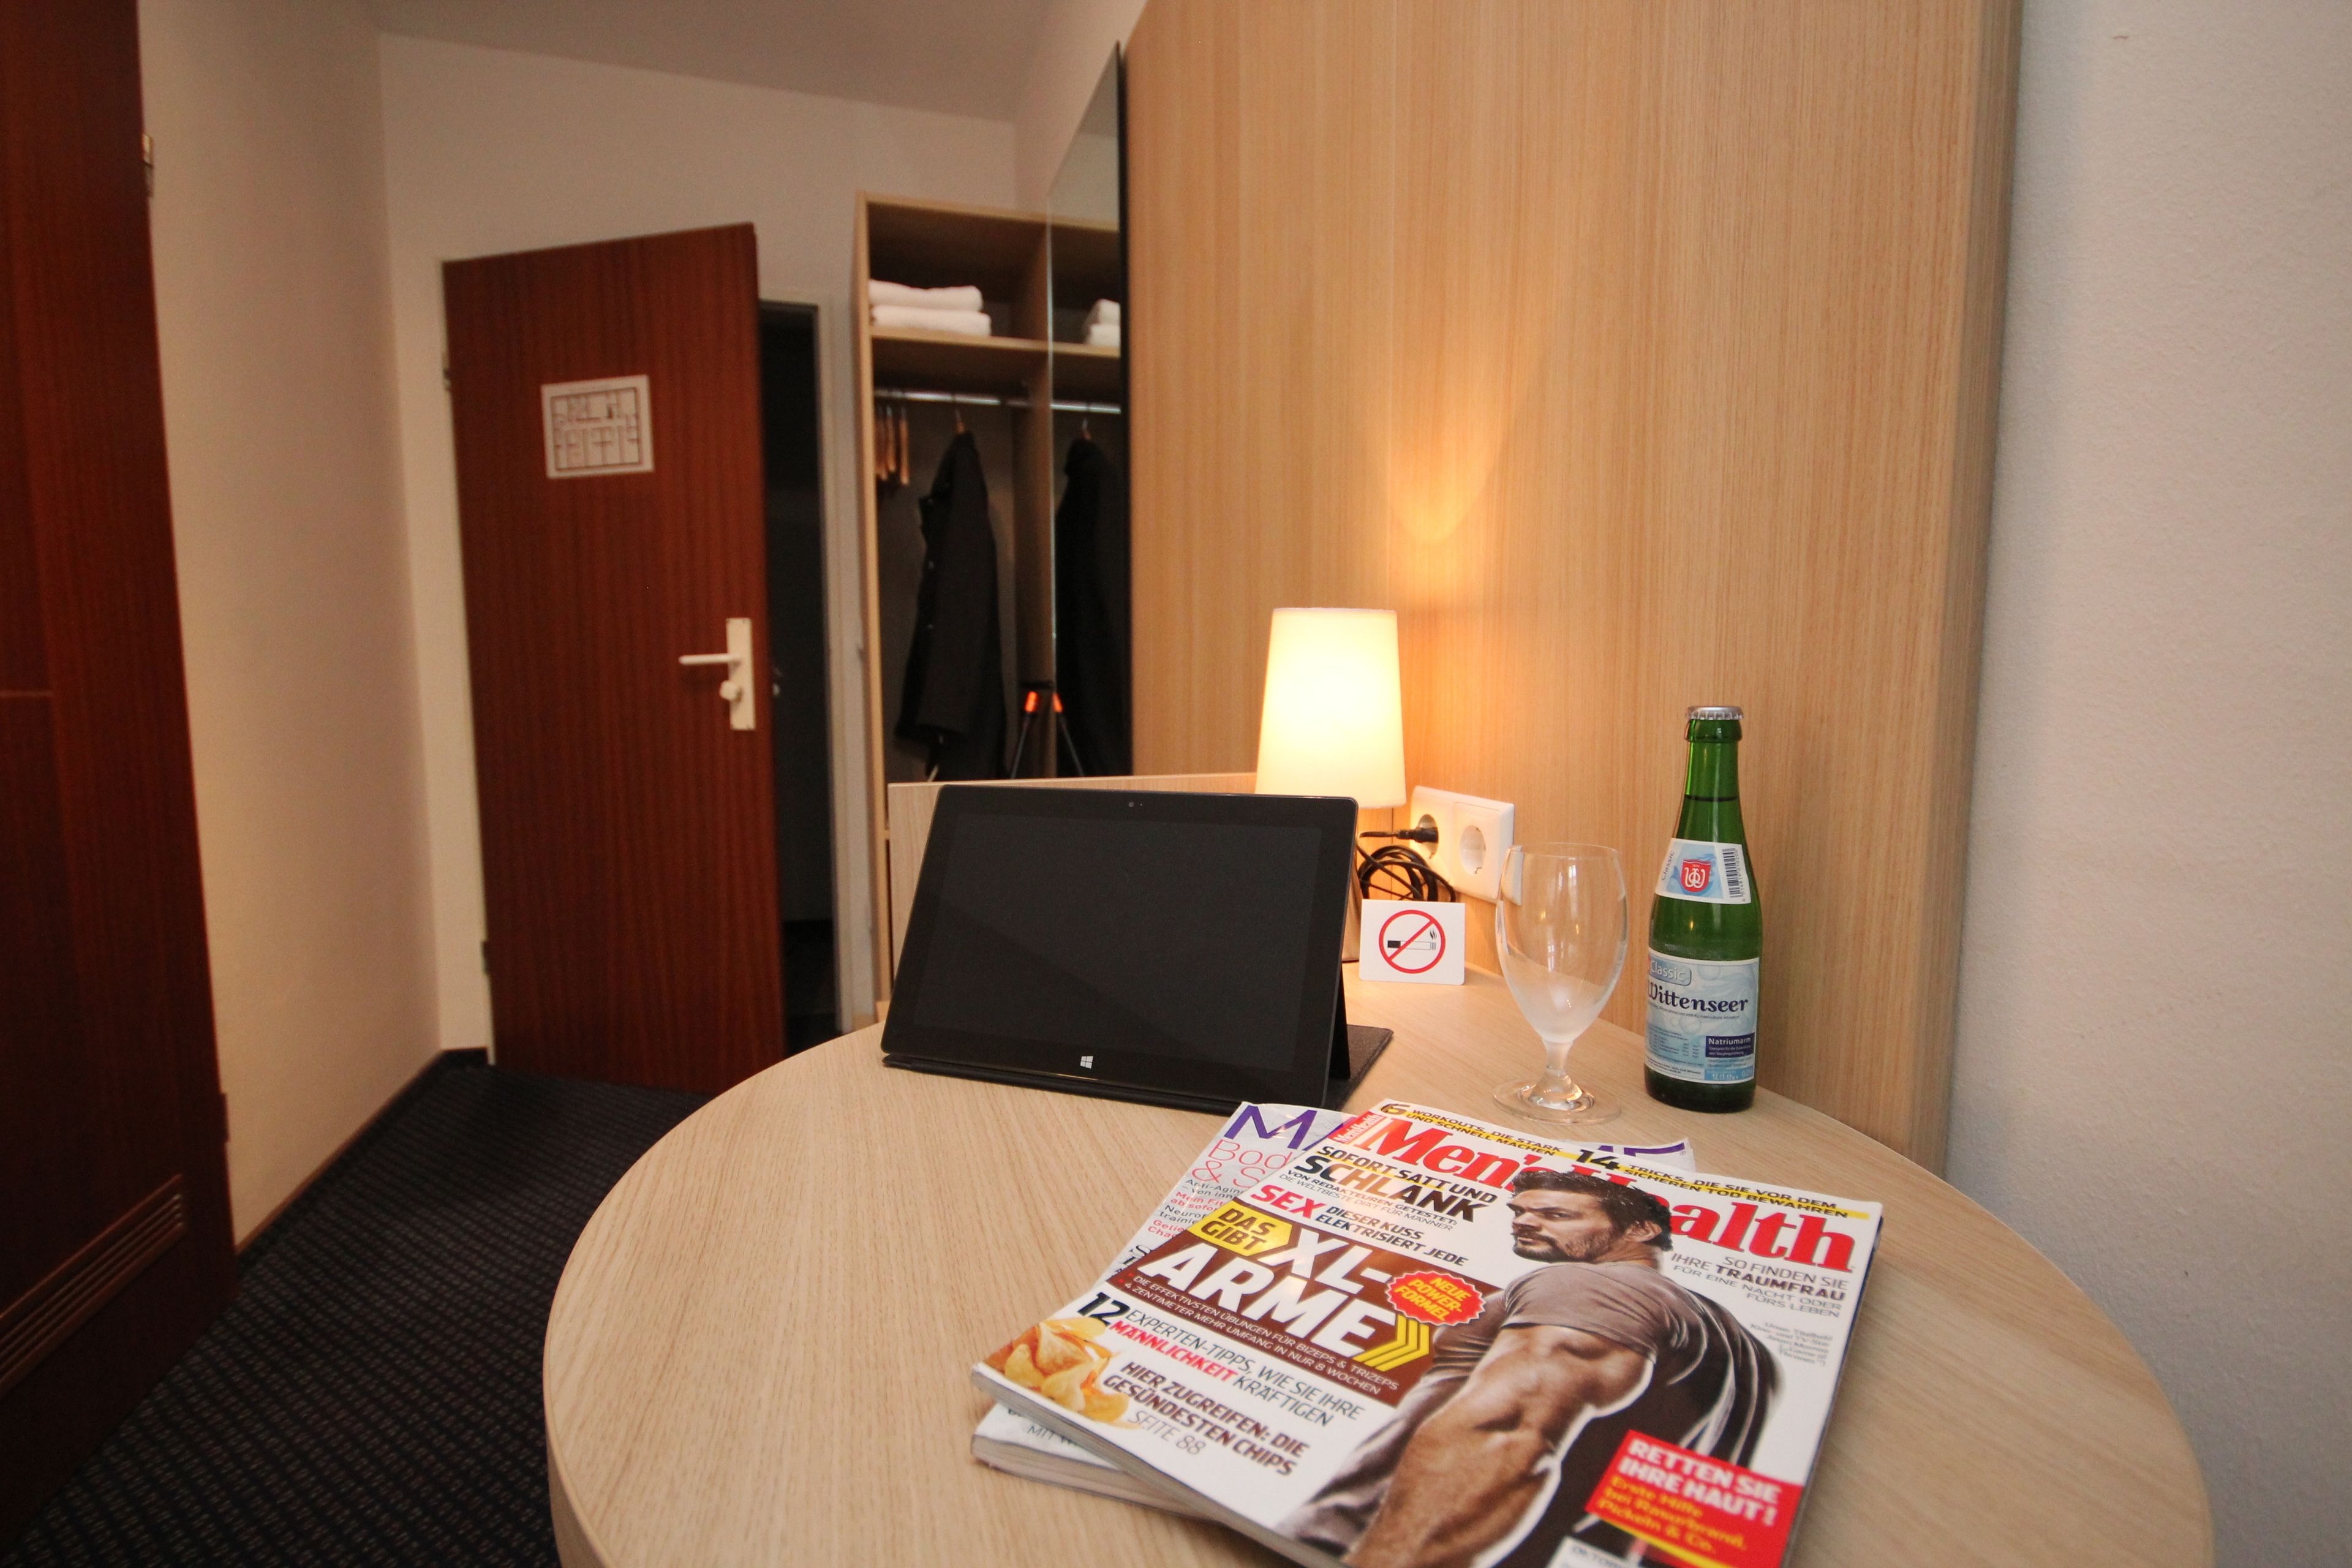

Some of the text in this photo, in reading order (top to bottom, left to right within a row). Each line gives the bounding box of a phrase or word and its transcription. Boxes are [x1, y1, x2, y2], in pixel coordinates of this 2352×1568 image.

[1651, 960, 1686, 981] Classic
[1708, 1037, 1751, 1046] Natriumarm
[1381, 1104, 1411, 1115] 6
[1408, 1113, 1556, 1156] UND SCHNELL MACHEN
[1412, 1110, 1562, 1153] WORKOUTS, DIE STARK
[1191, 1160, 1224, 1183] &
[1207, 1139, 1296, 1170] Bod
[1576, 1150, 1621, 1170] 14
[1185, 1179, 1244, 1194] Anti-Agin
[1294, 1155, 1490, 1223] SCHLANK
[1316, 1146, 1498, 1204] SOFORT SATT UND
[1624, 1169, 1849, 1218] SICHEREN TOD BEWAHREN
[1629, 1164, 1689, 1183] TRICKS,
[1755, 1189, 1792, 1200] VOR
[1797, 1197, 1837, 1208] DEM
[1165, 1205, 1207, 1220] Neurof
[1170, 1198, 1186, 1207] ab
[1175, 1191, 1226, 1208] Mein Fit
[1214, 1191, 1237, 1200] inn
[1250, 1184, 1328, 1219] SEX
[1279, 1174, 1454, 1232] DIE WELTBESTE DIÄT FÜR MÄNNER
[1287, 1170, 1458, 1226] VON REDAKTEUREN GETESTET:
[1153, 1219, 1186, 1234] Gelie
[1200, 1220, 1268, 1251] GIBT
[1218, 1208, 1277, 1236] DAS
[1315, 1214, 1471, 1267] ELEKTRISIERT JEDE
[1326, 1206, 1425, 1240] DIESER KUSS
[1257, 1227, 1392, 1295] XL-
[1671, 1253, 1847, 1302] IHRE TRAUMFRAU
[1723, 1256, 1850, 1291] SO FINDEN SIE
[1137, 1242, 1397, 1358] ARME
[1393, 1285, 1451, 1321] FORMEL
[1408, 1279, 1463, 1312] POWER-
[1430, 1277, 1472, 1302] NEUE
[1673, 1264, 1843, 1311] FÜR EINE NACHT ODER
[1746, 1291, 1841, 1318] FÜRS LEBEN
[1077, 1291, 1132, 1327] 12
[1133, 1276, 1400, 1391] DIE EFFEKTIVSTEN ÜBUNGEN FÜR BIZEPS & TRIZEPS
[1133, 1285, 1195, 1317] ZENTIMETER
[1194, 1313, 1227, 1330] MEHR
[1226, 1324, 1274, 1349] UMFANG
[1273, 1345, 1288, 1355] IN
[1287, 1351, 1316, 1368] NUR
[1315, 1363, 1324, 1371] 8
[1326, 1367, 1382, 1395] WOCHEN
[1108, 1320, 1333, 1428] MÄNNLICHKEIT KRÄFTIGEN
[1125, 1310, 1366, 1420] EXPERTEN-TIPPS, WIE SIE IHRE
[1102, 1374, 1298, 1477] GESÜNDESTEN CHIPS
[1119, 1361, 1311, 1458] HIER ZUGREIFEN: DIE
[1127, 1410, 1207, 1456] SEITE 88
[1616, 1455, 1683, 1494] IHRE
[1627, 1438, 1782, 1505] RETTEN SIE
